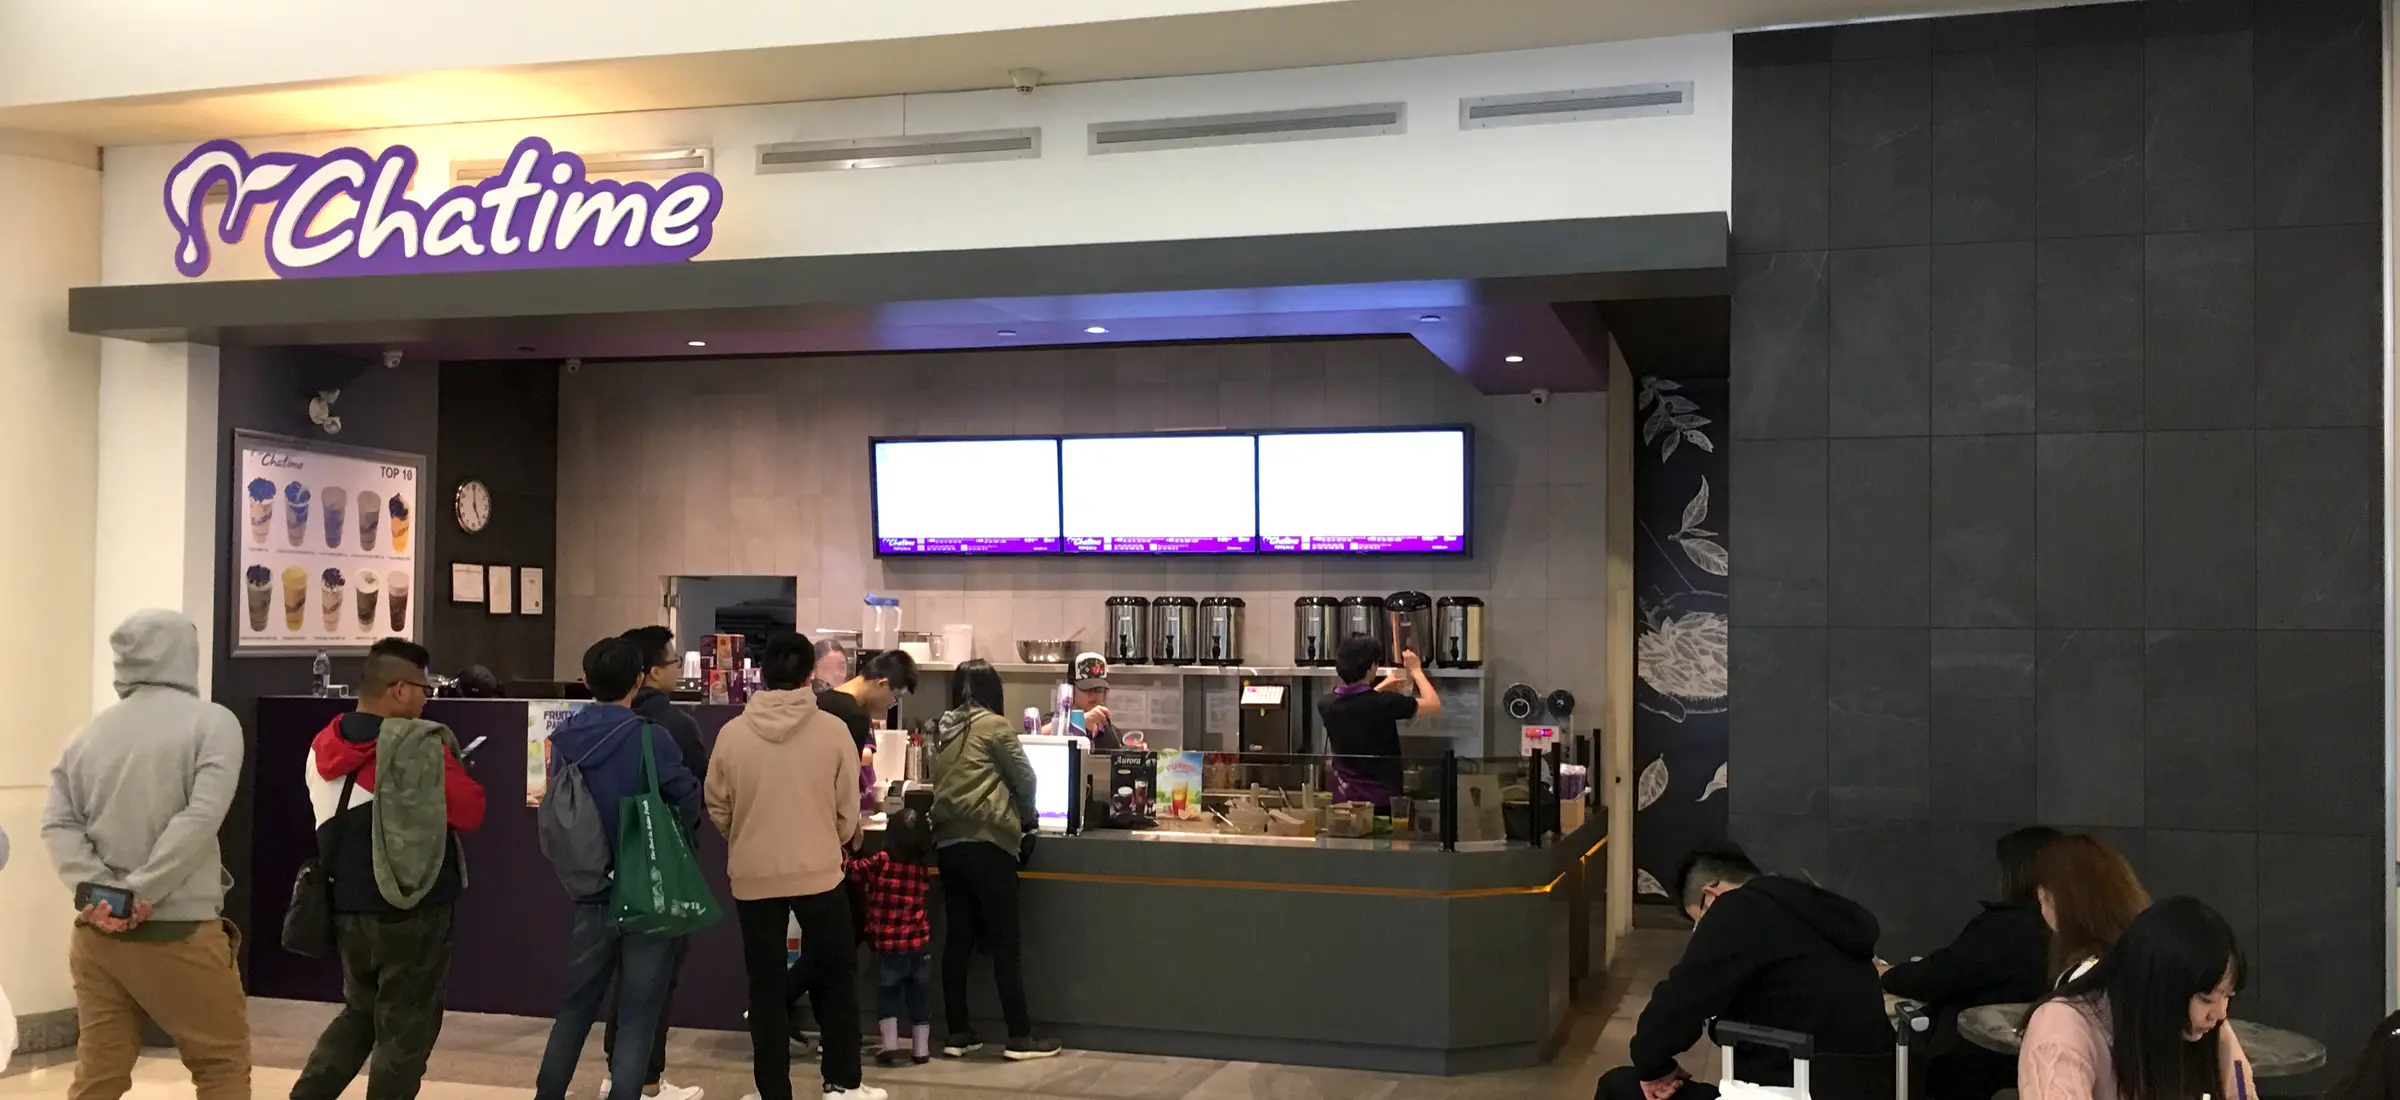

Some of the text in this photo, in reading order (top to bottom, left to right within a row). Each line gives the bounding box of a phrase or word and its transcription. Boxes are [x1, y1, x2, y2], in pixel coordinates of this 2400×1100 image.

[272, 147, 711, 267] Chatime
[261, 452, 304, 470] Chatime
[380, 466, 413, 481] TOP 10
[1114, 756, 1141, 765] Aurora
